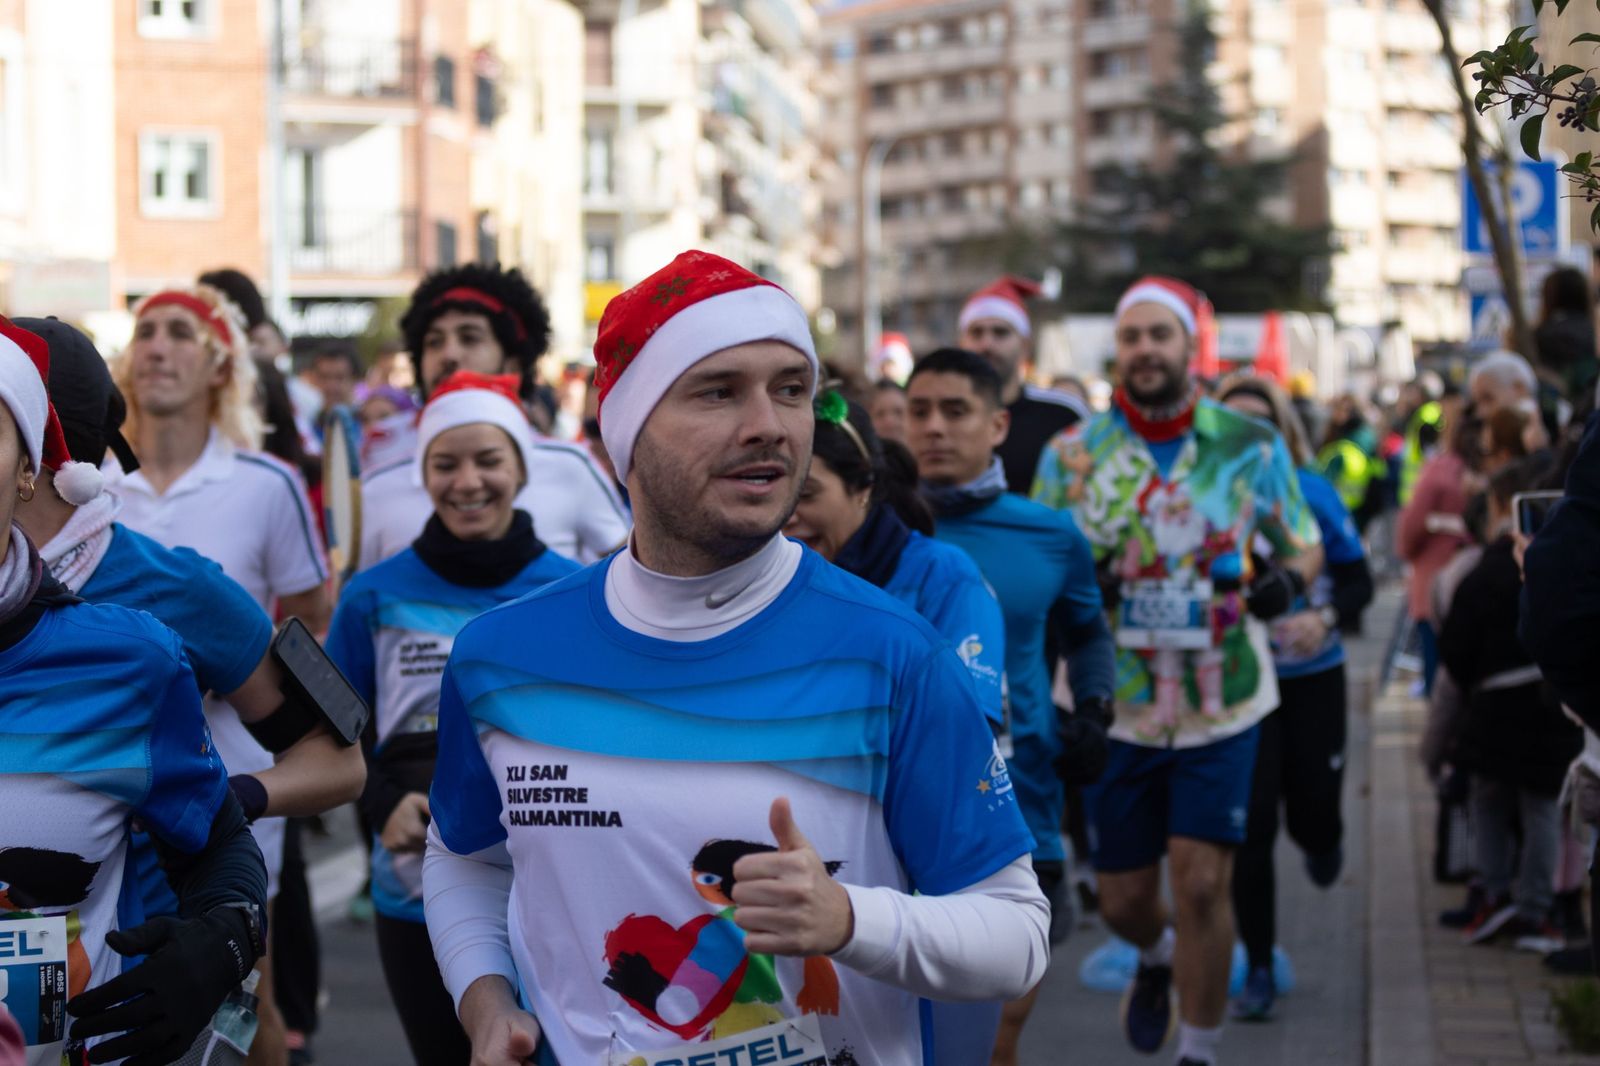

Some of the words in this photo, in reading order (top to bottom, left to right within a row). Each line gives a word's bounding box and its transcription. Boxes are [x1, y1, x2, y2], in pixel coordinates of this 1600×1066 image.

[506, 766, 526, 782] XLI
[529, 764, 568, 781] SAN
[507, 787, 588, 804] SILVESTRE
[509, 809, 623, 828] SALMANTINA
[56, 970, 64, 993] 4958
